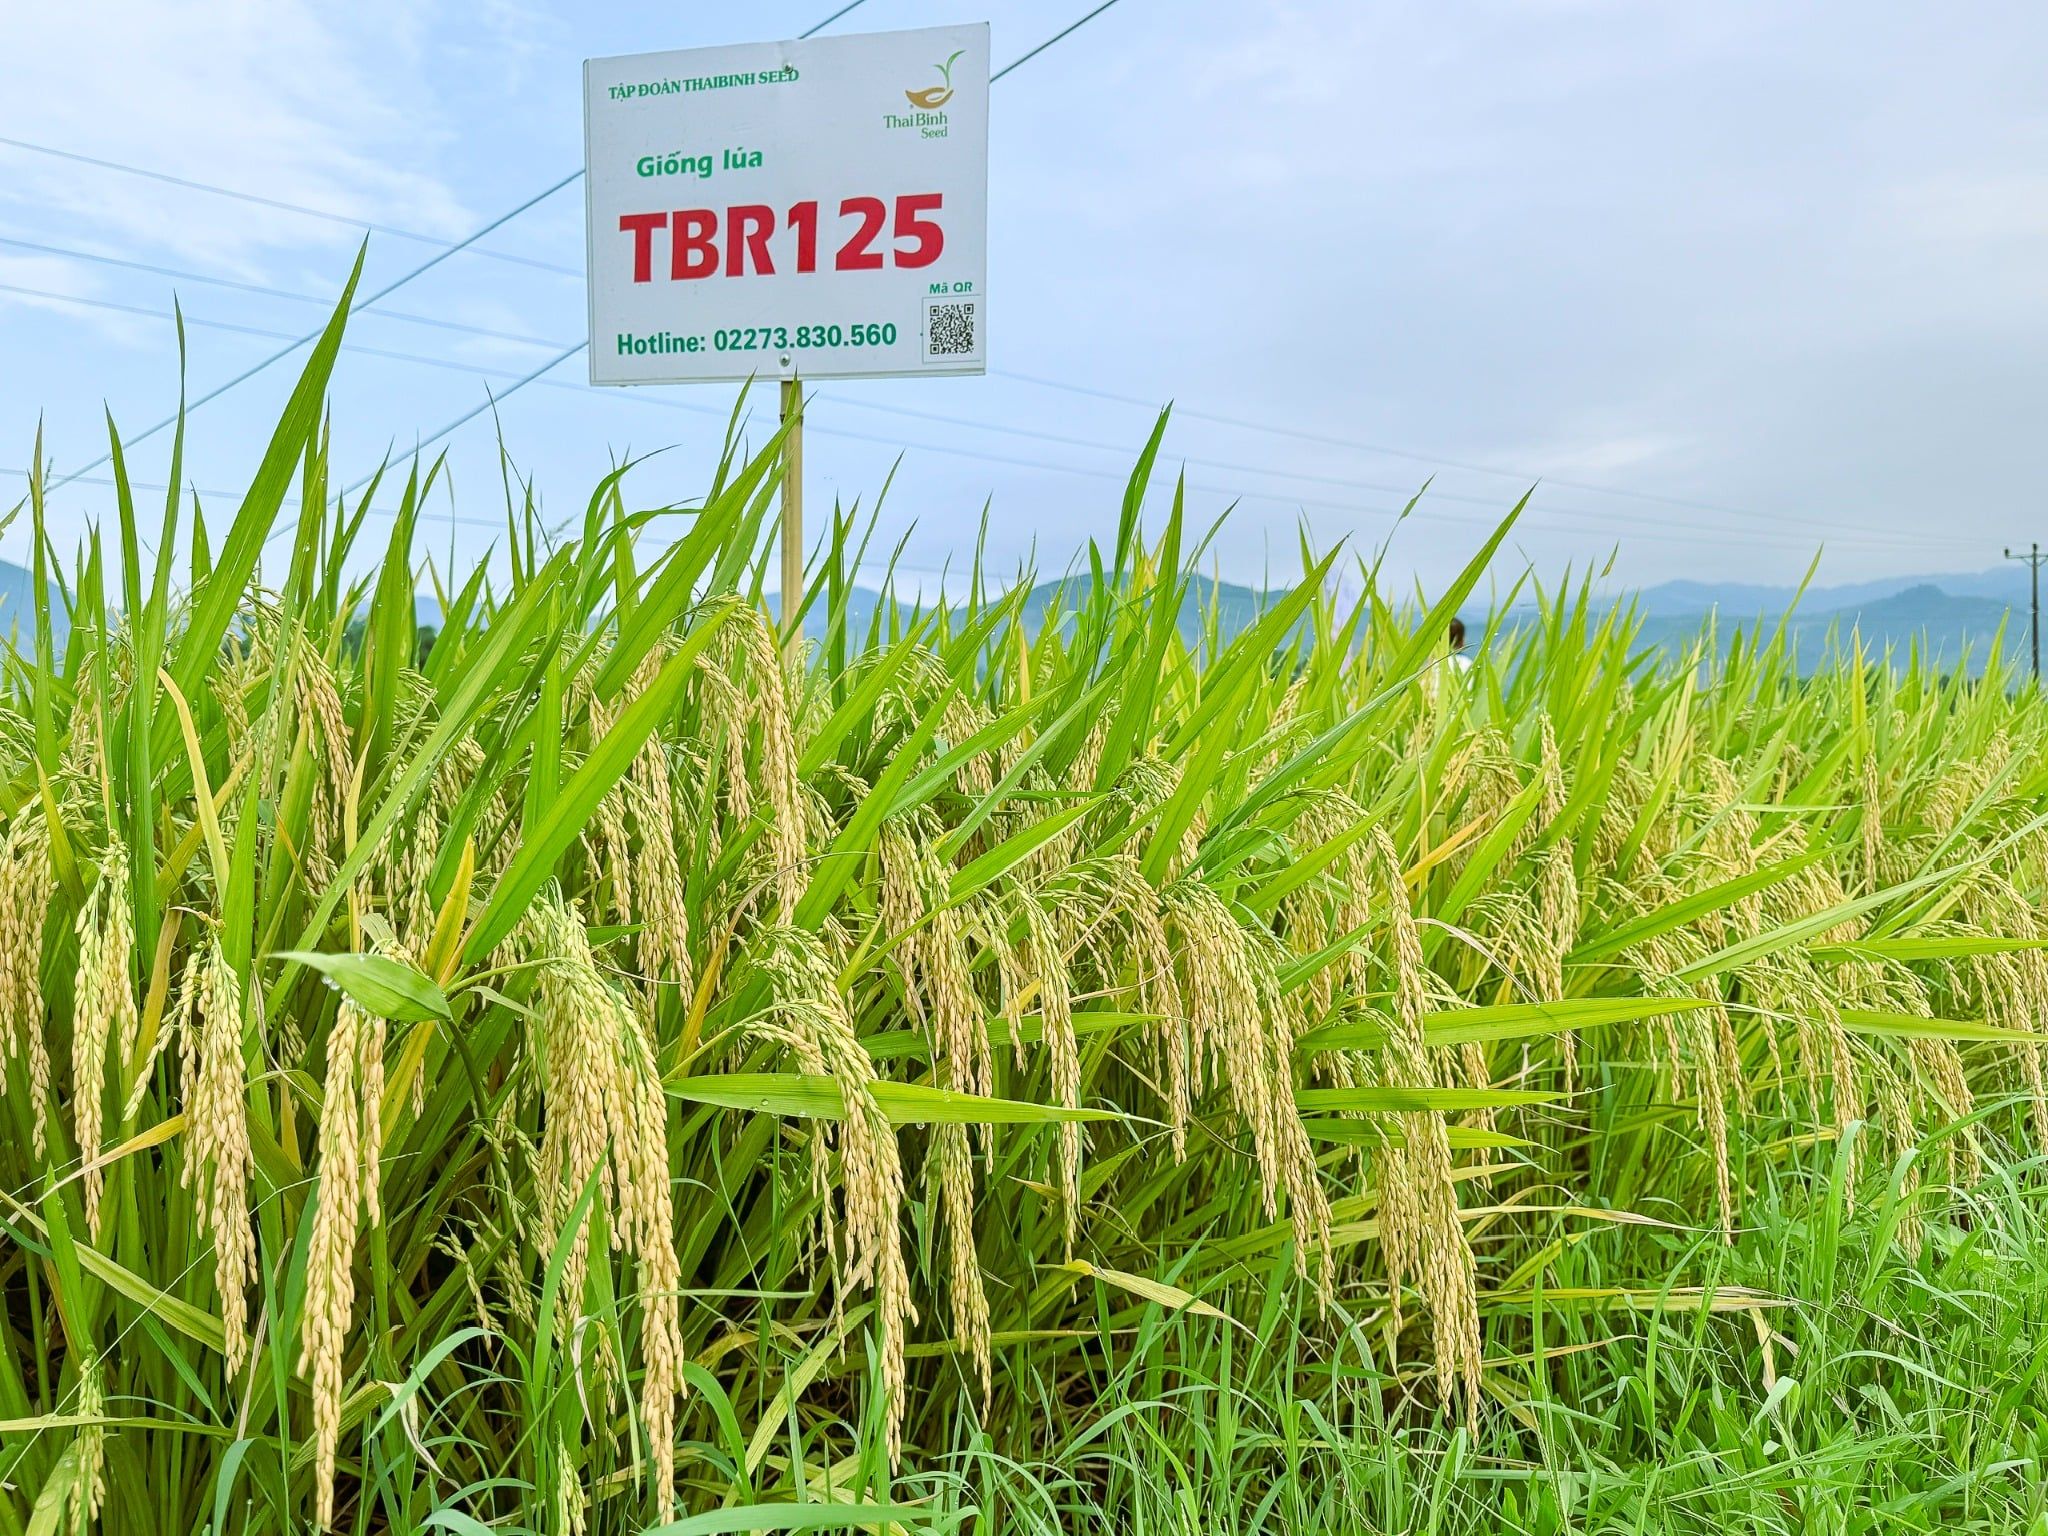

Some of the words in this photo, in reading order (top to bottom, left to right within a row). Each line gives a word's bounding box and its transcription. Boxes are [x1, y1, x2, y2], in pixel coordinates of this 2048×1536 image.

[608, 83, 636, 102] TẬP
[638, 78, 681, 97] ĐOÀN
[683, 72, 756, 92] THAIBINH
[758, 69, 800, 84] SEED
[921, 126, 948, 139] Seed
[636, 150, 713, 179] Giống
[723, 147, 763, 170] lúa
[619, 193, 945, 283] TBR125
[953, 281, 973, 293] QR
[617, 332, 706, 355] Hotline:
[713, 323, 898, 352] 02273.830.560
